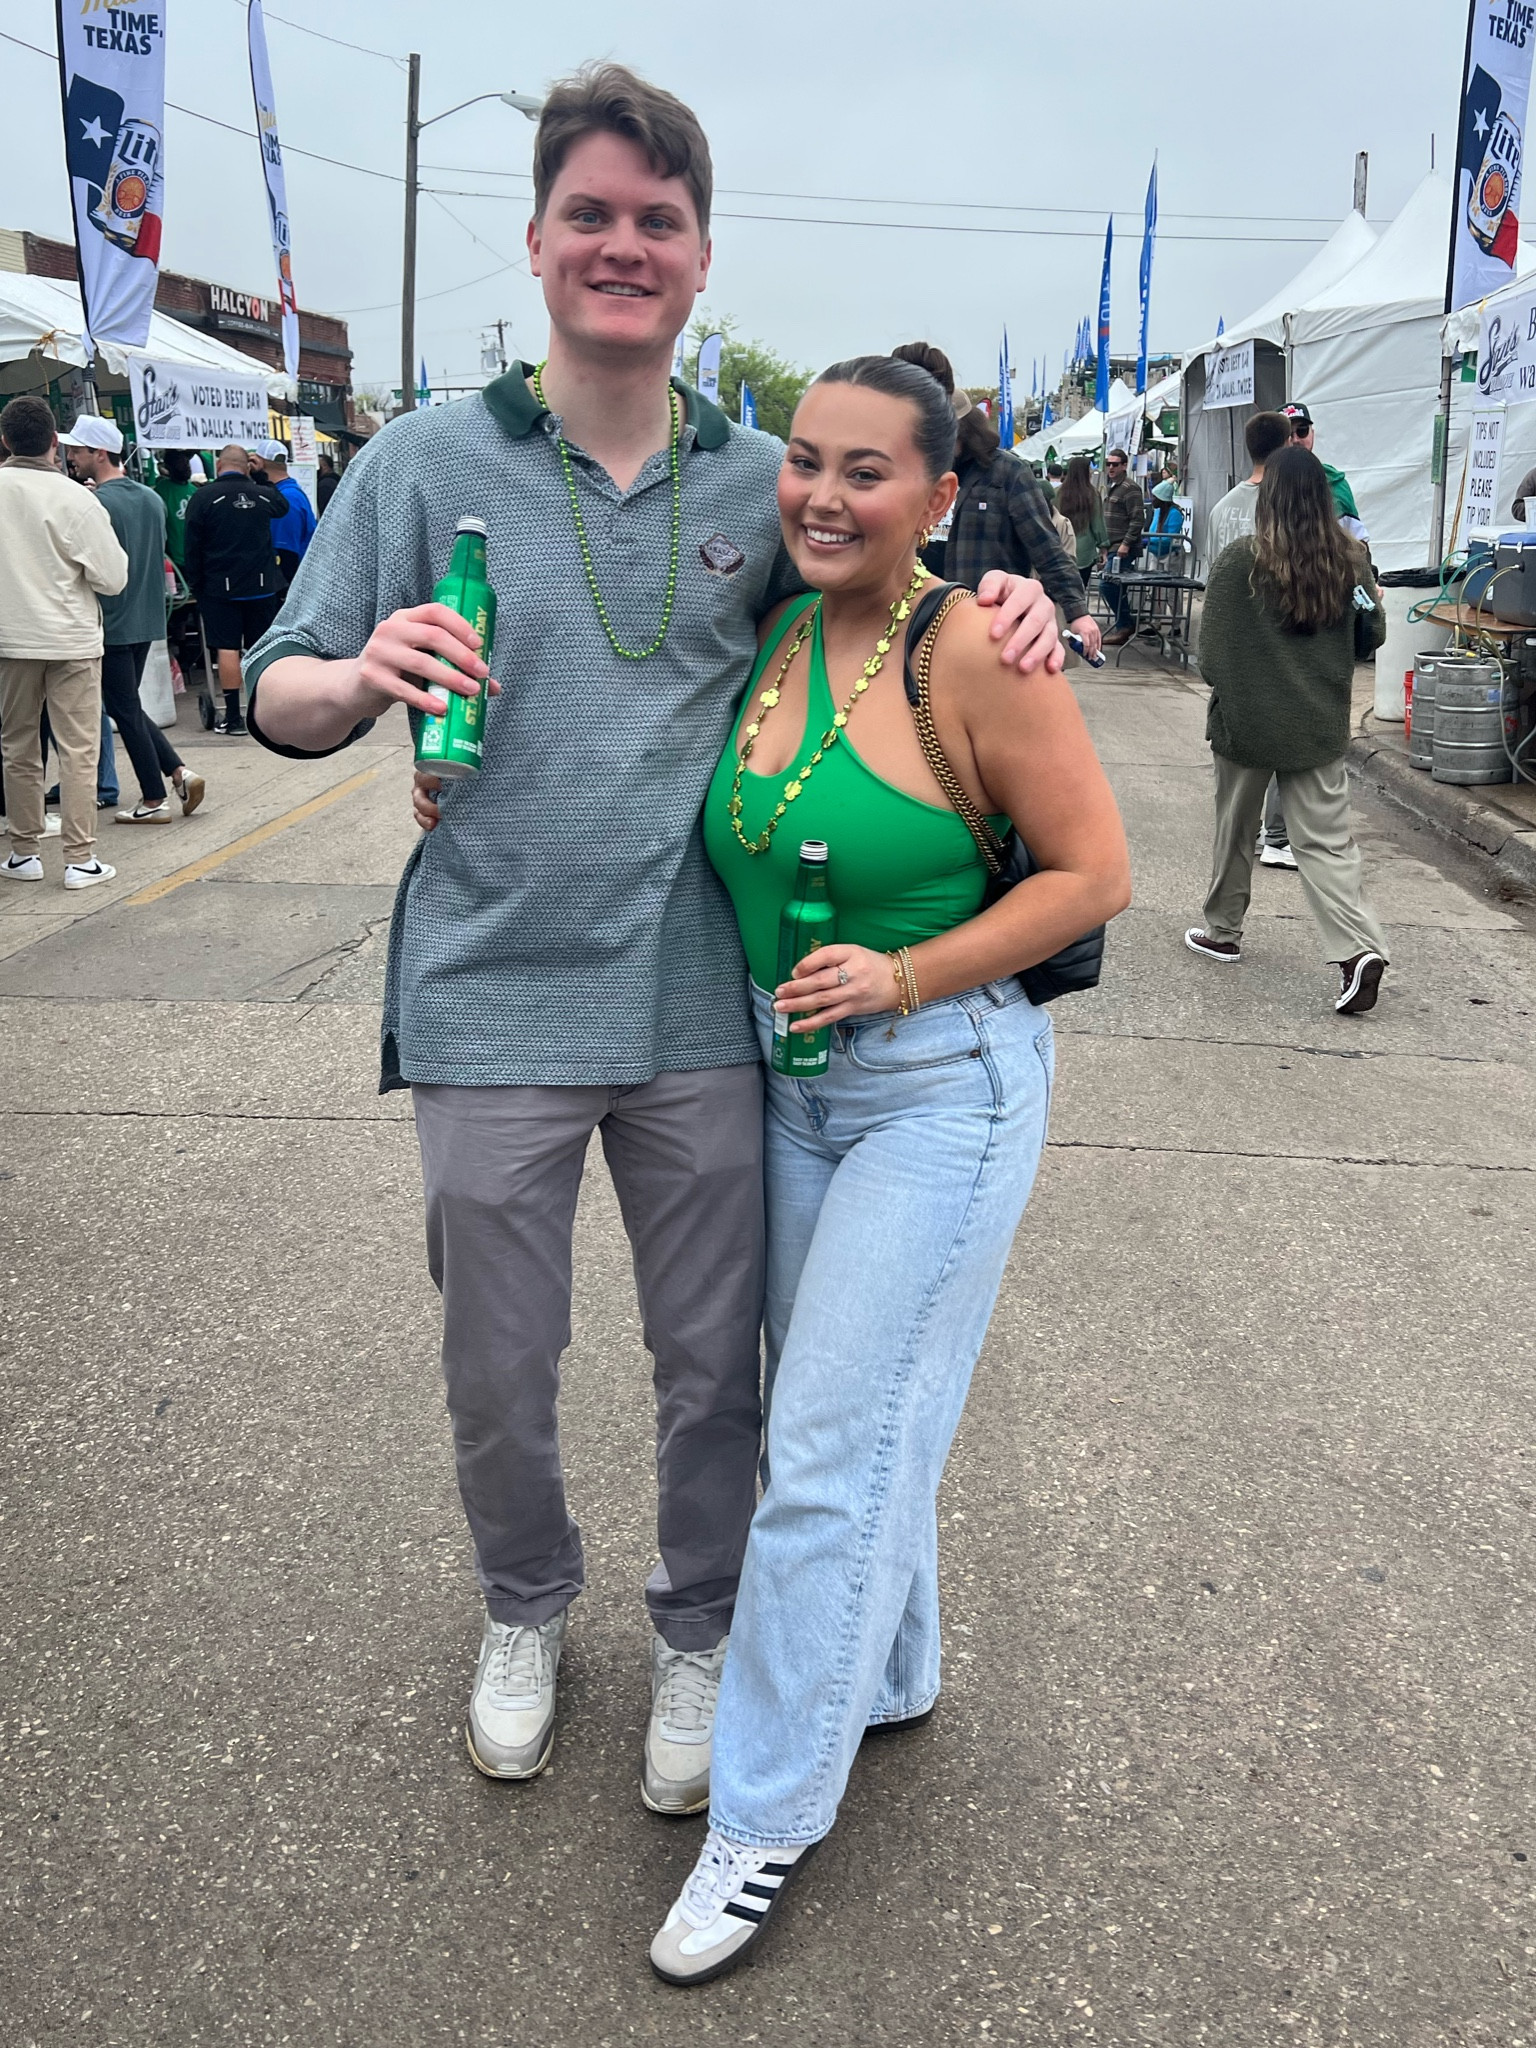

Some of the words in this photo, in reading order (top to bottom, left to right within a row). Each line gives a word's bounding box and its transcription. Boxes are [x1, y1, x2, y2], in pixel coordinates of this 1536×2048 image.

[107, 8, 163, 38] TIME,
[1489, 14, 1526, 48] TEXAS
[83, 24, 152, 56] TEXAS
[118, 129, 157, 165] Lit
[1490, 123, 1519, 170] Lite
[211, 286, 269, 322] HALCYON
[191, 384, 222, 408] VOTED
[225, 388, 244, 409] BEST
[246, 391, 260, 410] BAR
[185, 416, 198, 437] IN
[1476, 421, 1487, 440] TIPS
[1489, 421, 1500, 440] NOT
[1472, 450, 1496, 469] INCLUDED
[1470, 478, 1492, 498] PLEASE
[1467, 505, 1476, 524] TIP
[1477, 506, 1490, 526] YOUR
[475, 605, 488, 635] DAY
